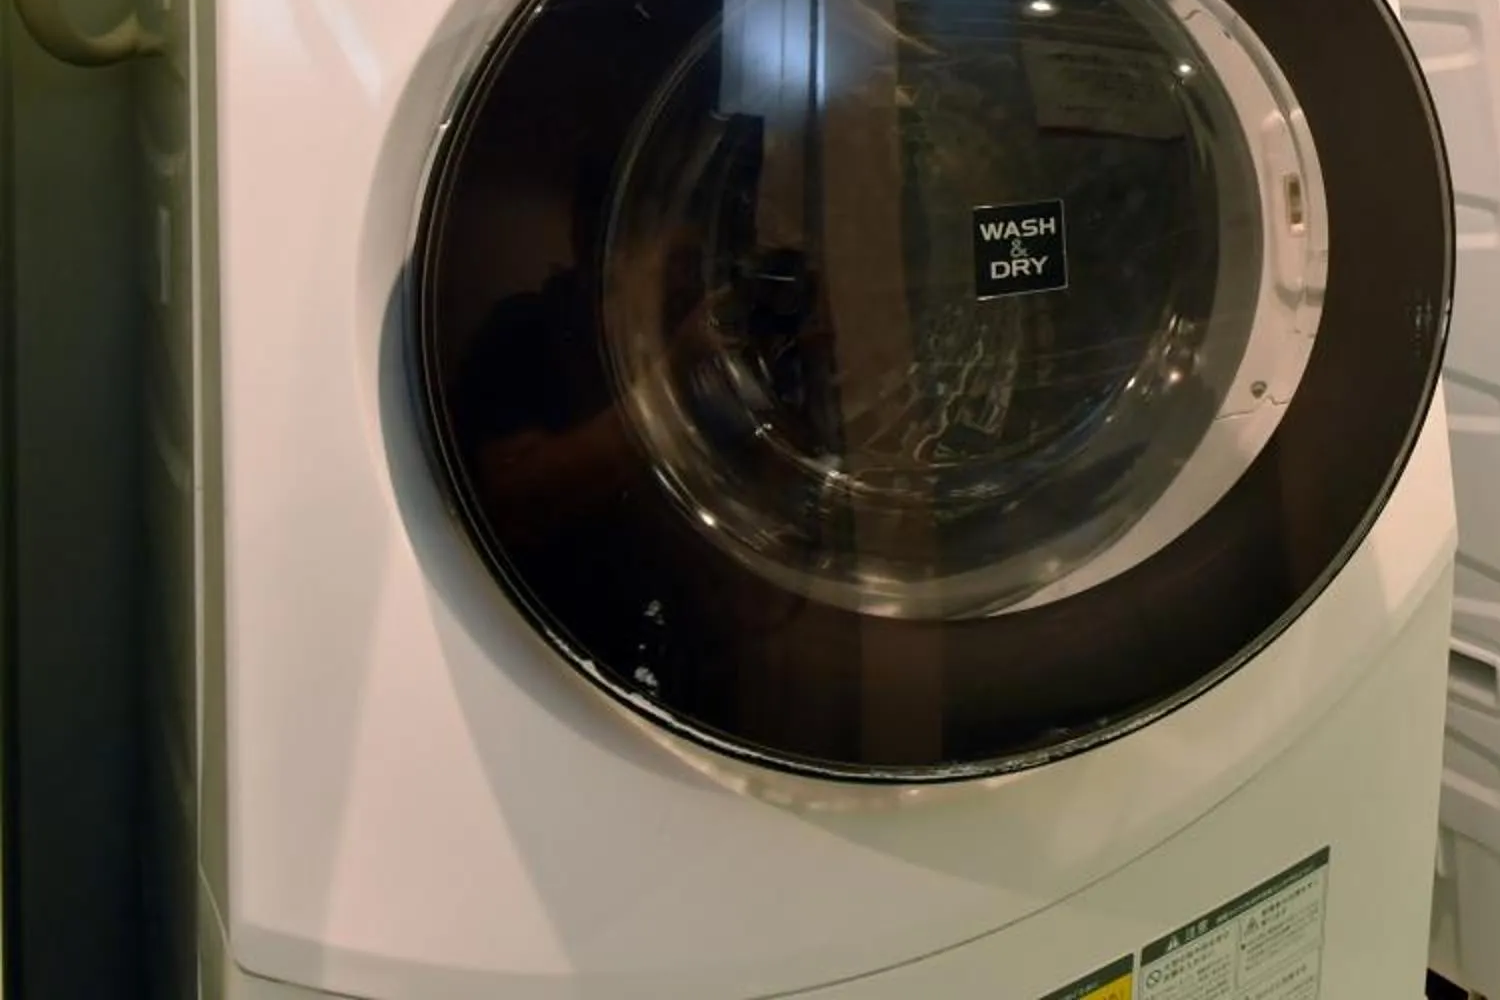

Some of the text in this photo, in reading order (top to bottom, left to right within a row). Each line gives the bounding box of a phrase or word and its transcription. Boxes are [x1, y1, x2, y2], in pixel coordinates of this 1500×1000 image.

[980, 216, 1056, 241] WASH
[1010, 239, 1030, 258] &
[990, 256, 1049, 280] DRY
